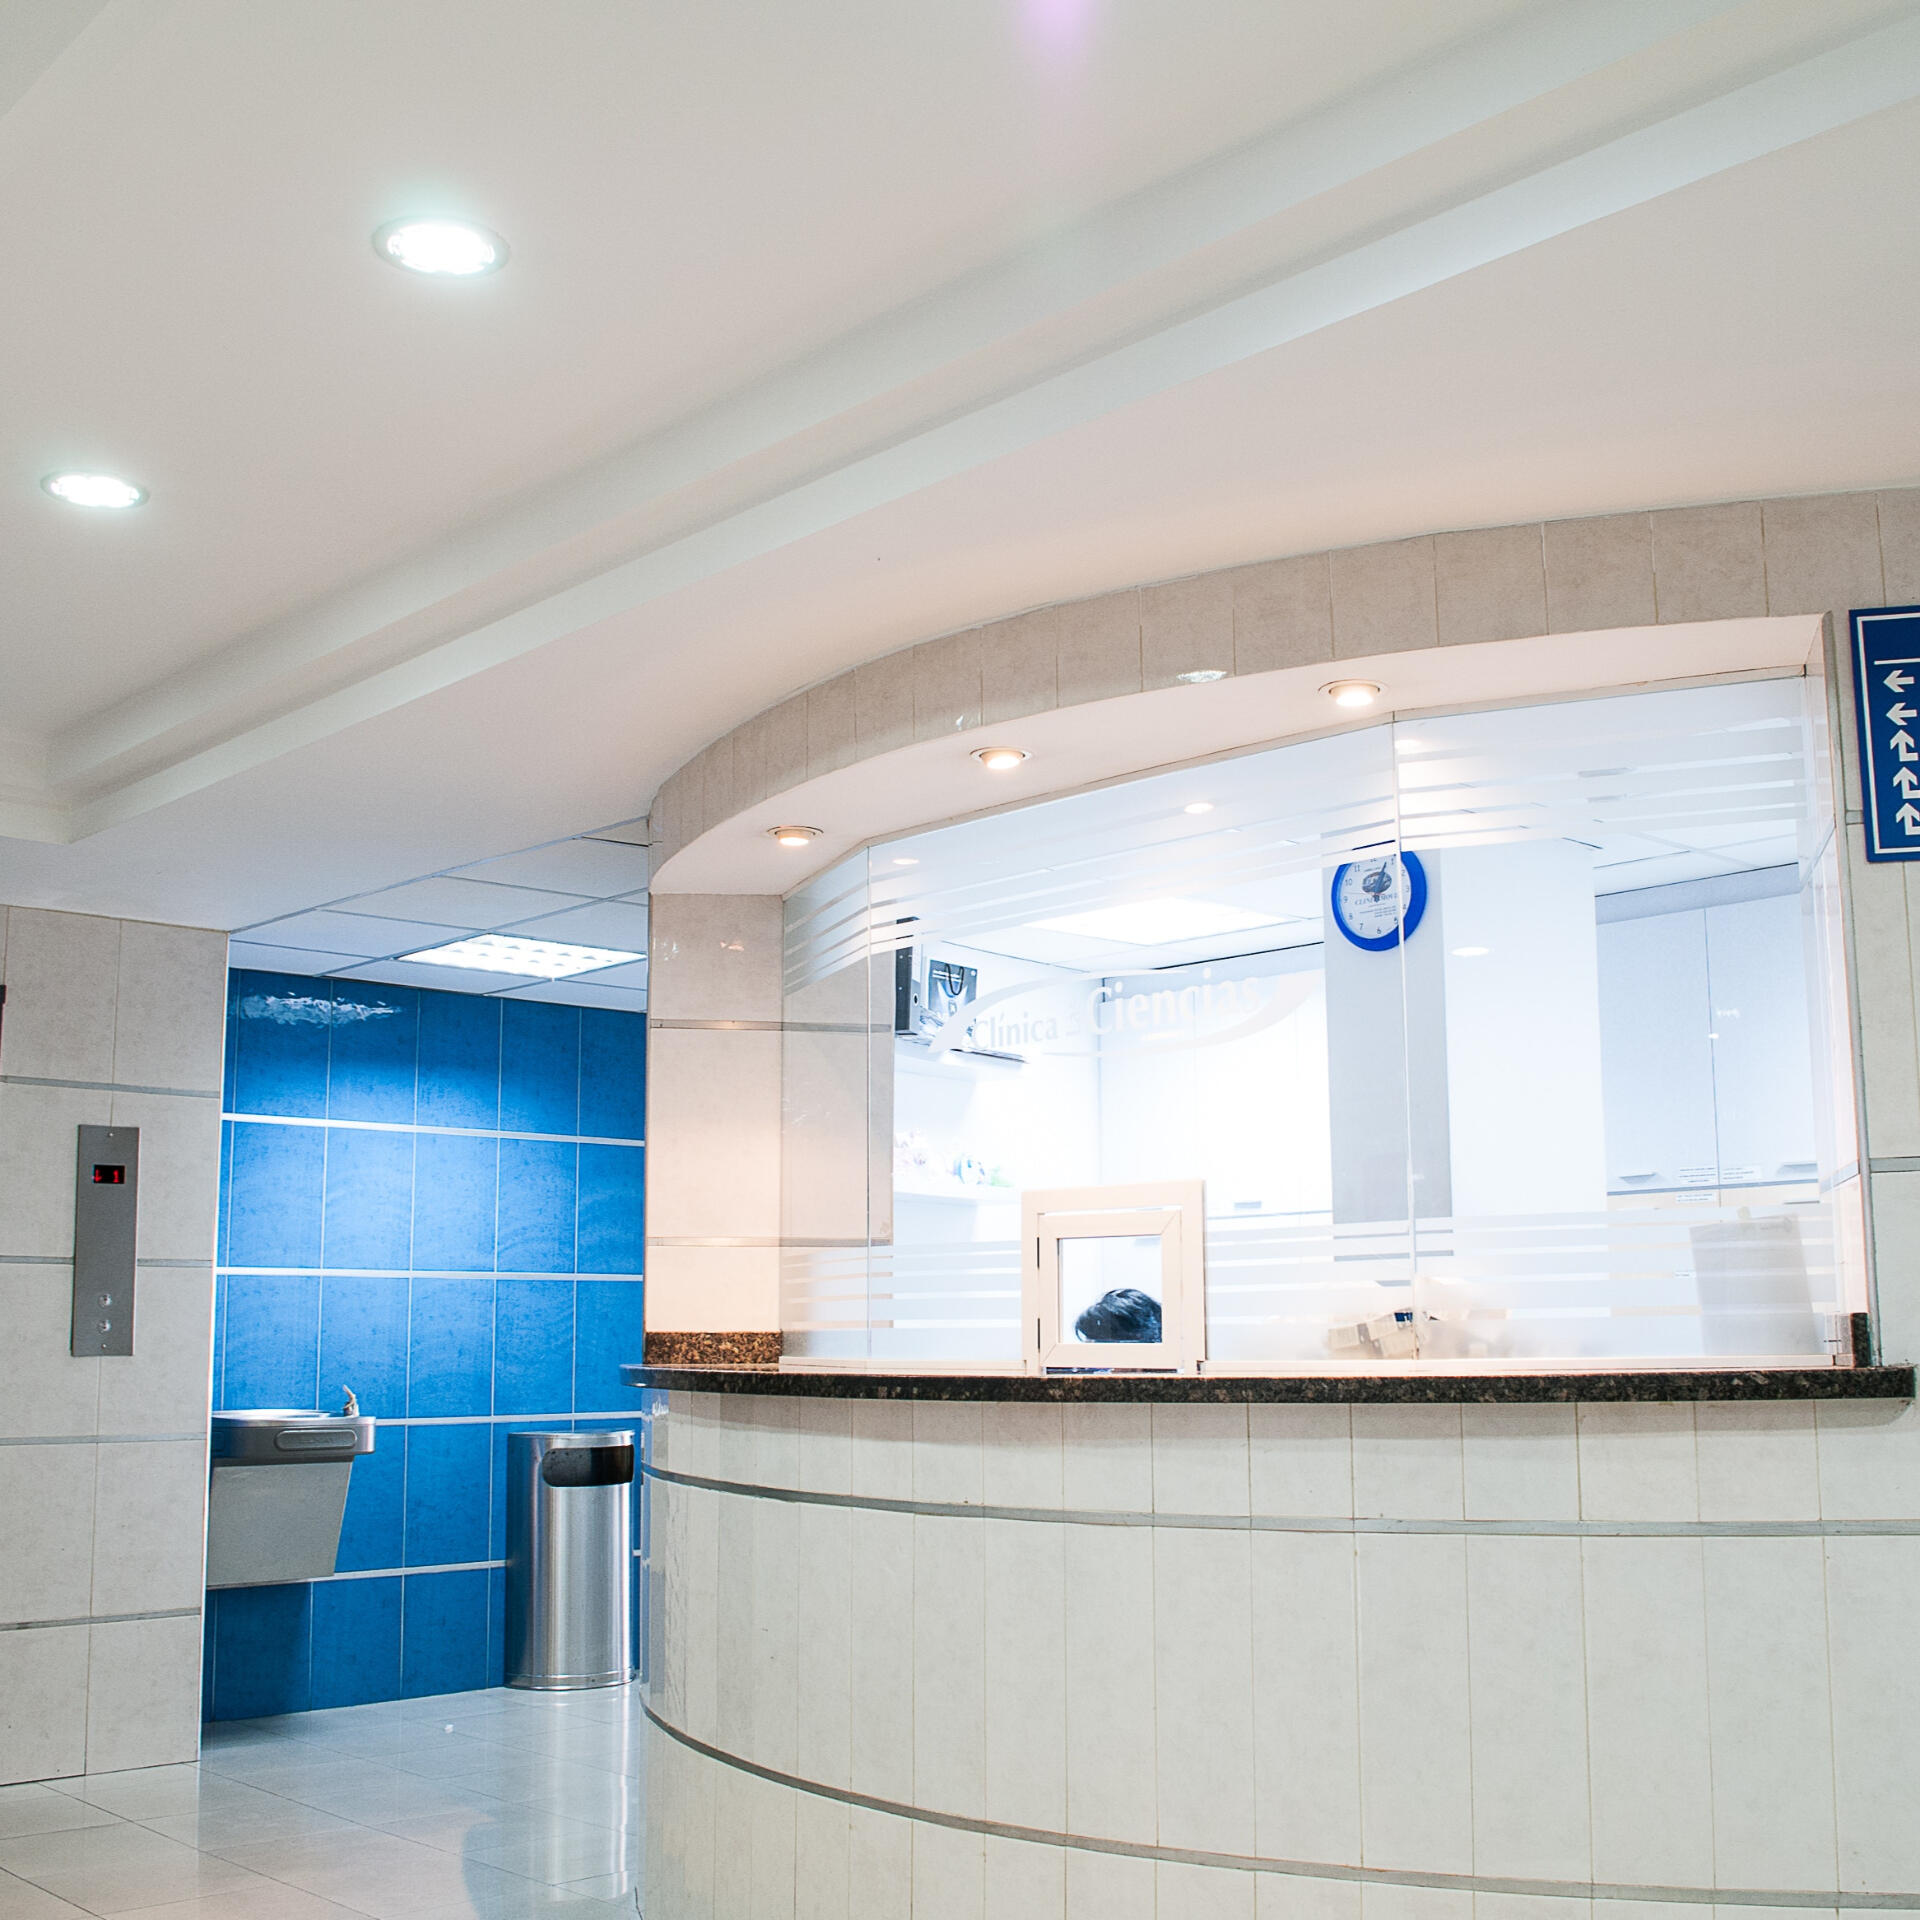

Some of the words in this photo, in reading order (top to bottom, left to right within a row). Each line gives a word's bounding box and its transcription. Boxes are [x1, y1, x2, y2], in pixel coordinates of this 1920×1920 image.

[972, 1012, 1059, 1049] Clínica
[1088, 967, 1260, 1036] Ciencias
[113, 1170, 119, 1183] 1
